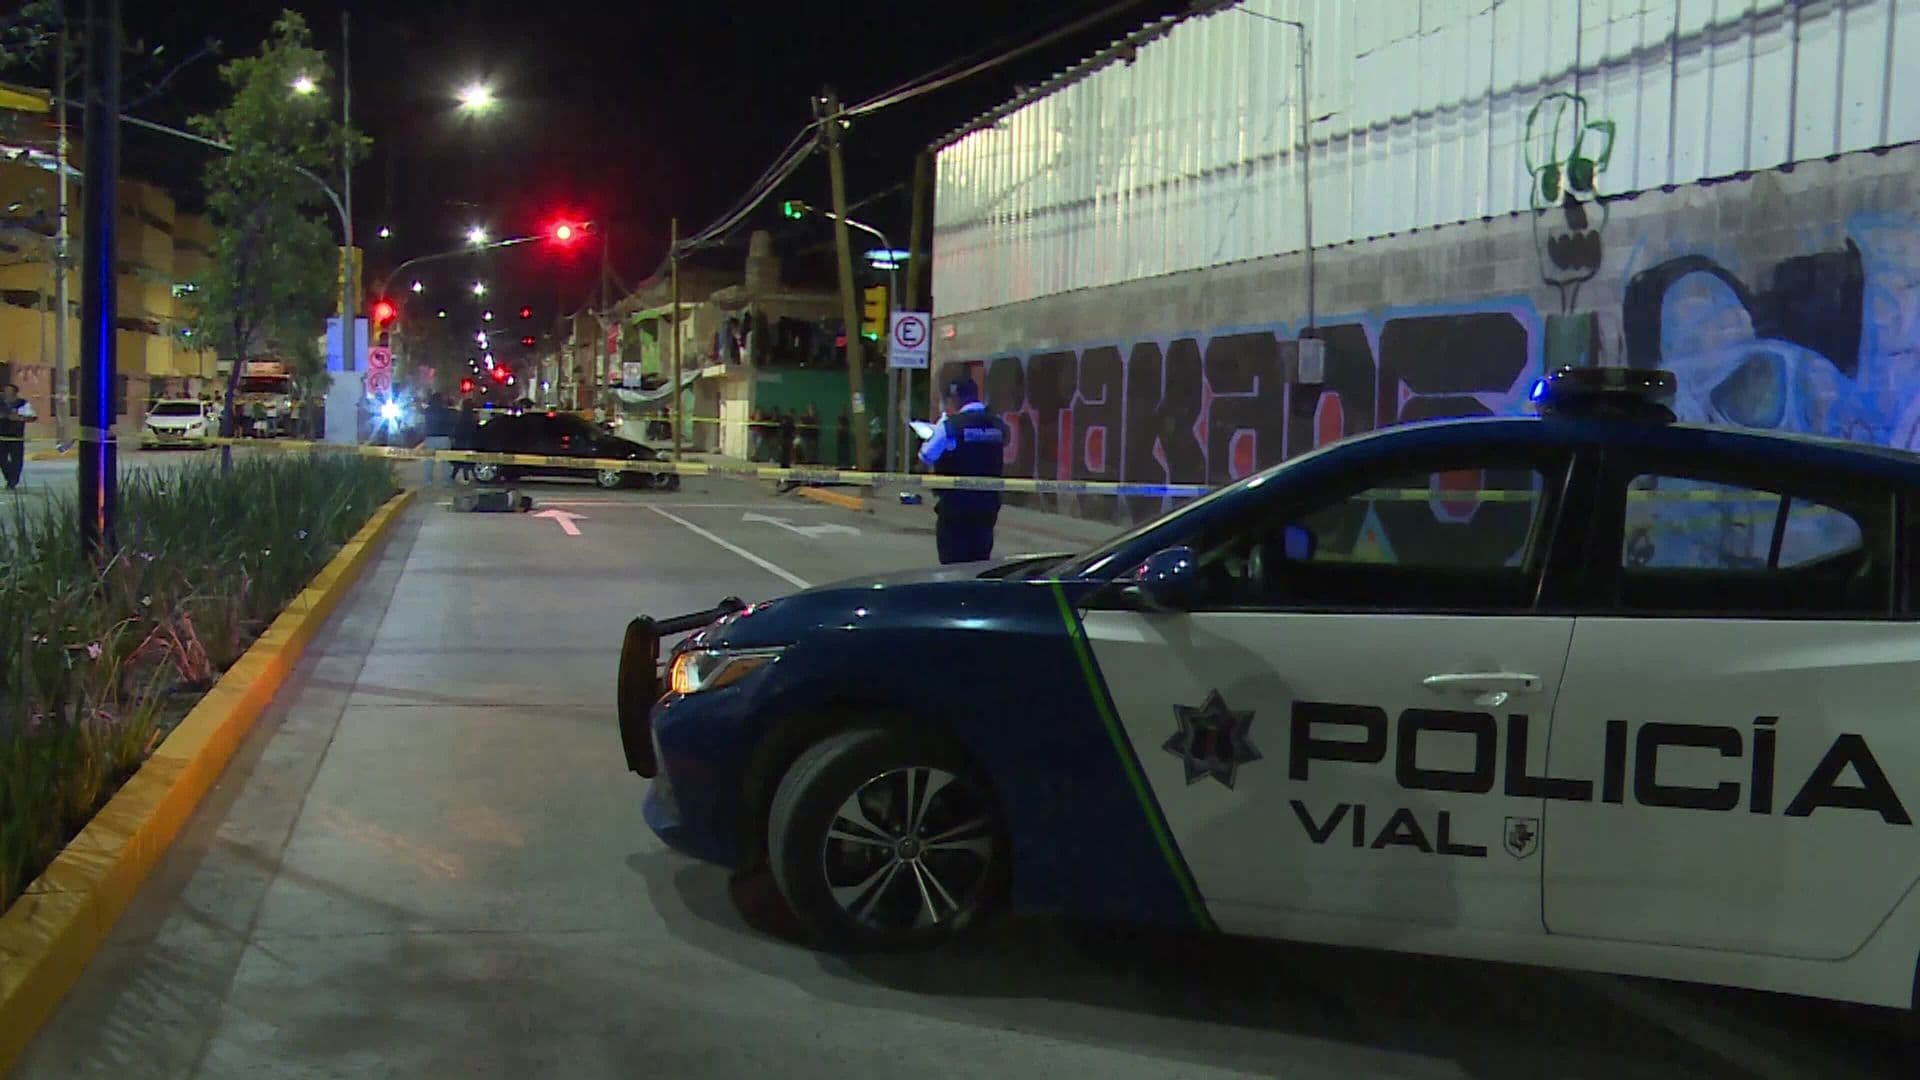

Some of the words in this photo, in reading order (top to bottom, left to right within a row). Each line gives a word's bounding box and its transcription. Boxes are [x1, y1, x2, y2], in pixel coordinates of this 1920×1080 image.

[903, 322, 916, 341] E
[1288, 700, 1912, 825] POLICÍA
[1289, 800, 1487, 857] VIAL
